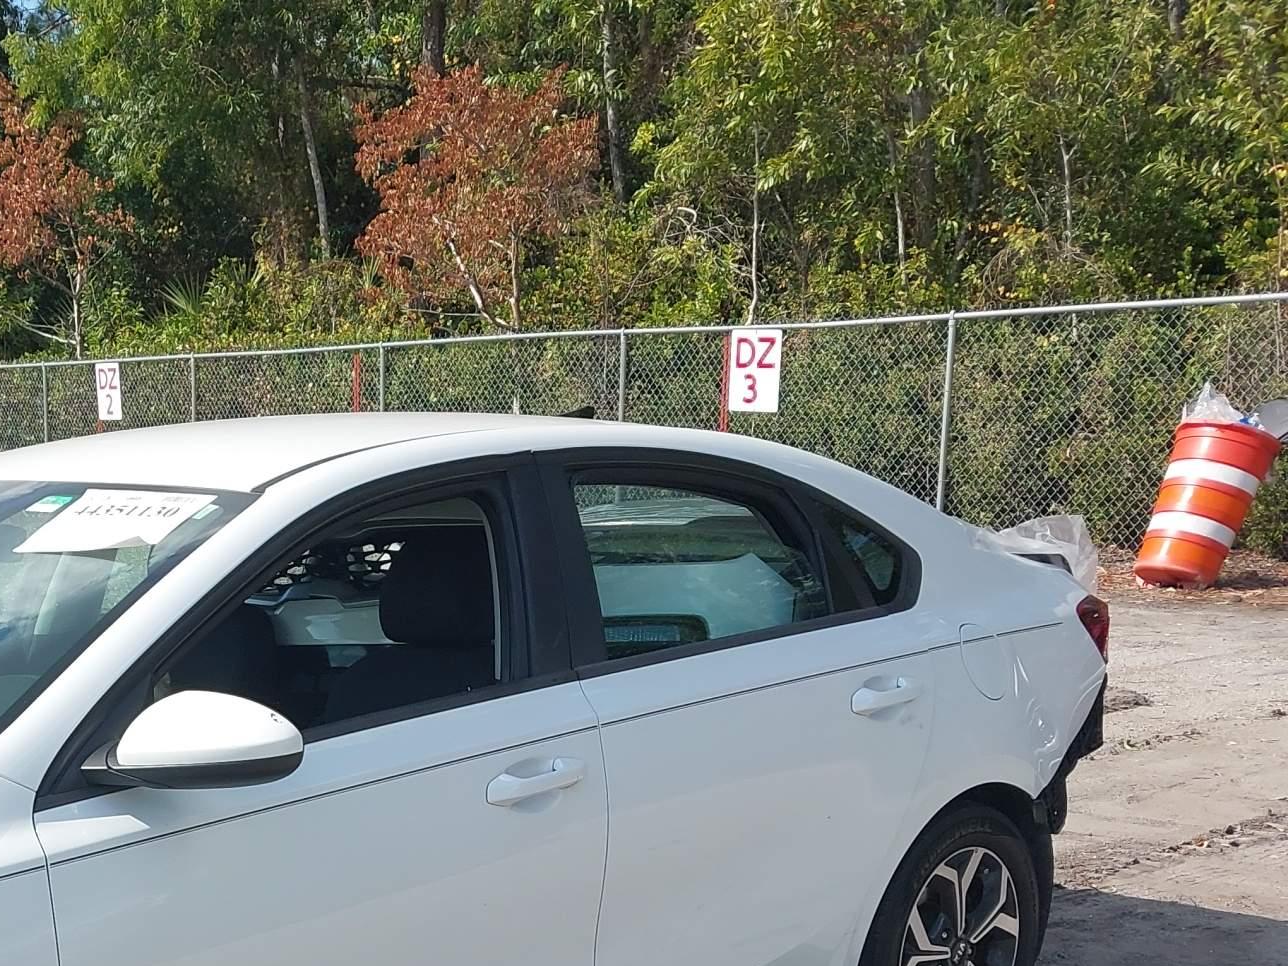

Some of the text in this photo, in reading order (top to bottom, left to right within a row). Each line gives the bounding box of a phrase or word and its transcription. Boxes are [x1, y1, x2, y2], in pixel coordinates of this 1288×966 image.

[735, 336, 777, 368] DZ
[98, 367, 118, 390] DZ
[742, 373, 758, 404] 3
[105, 393, 114, 416] 2
[73, 504, 181, 518] 44351130
